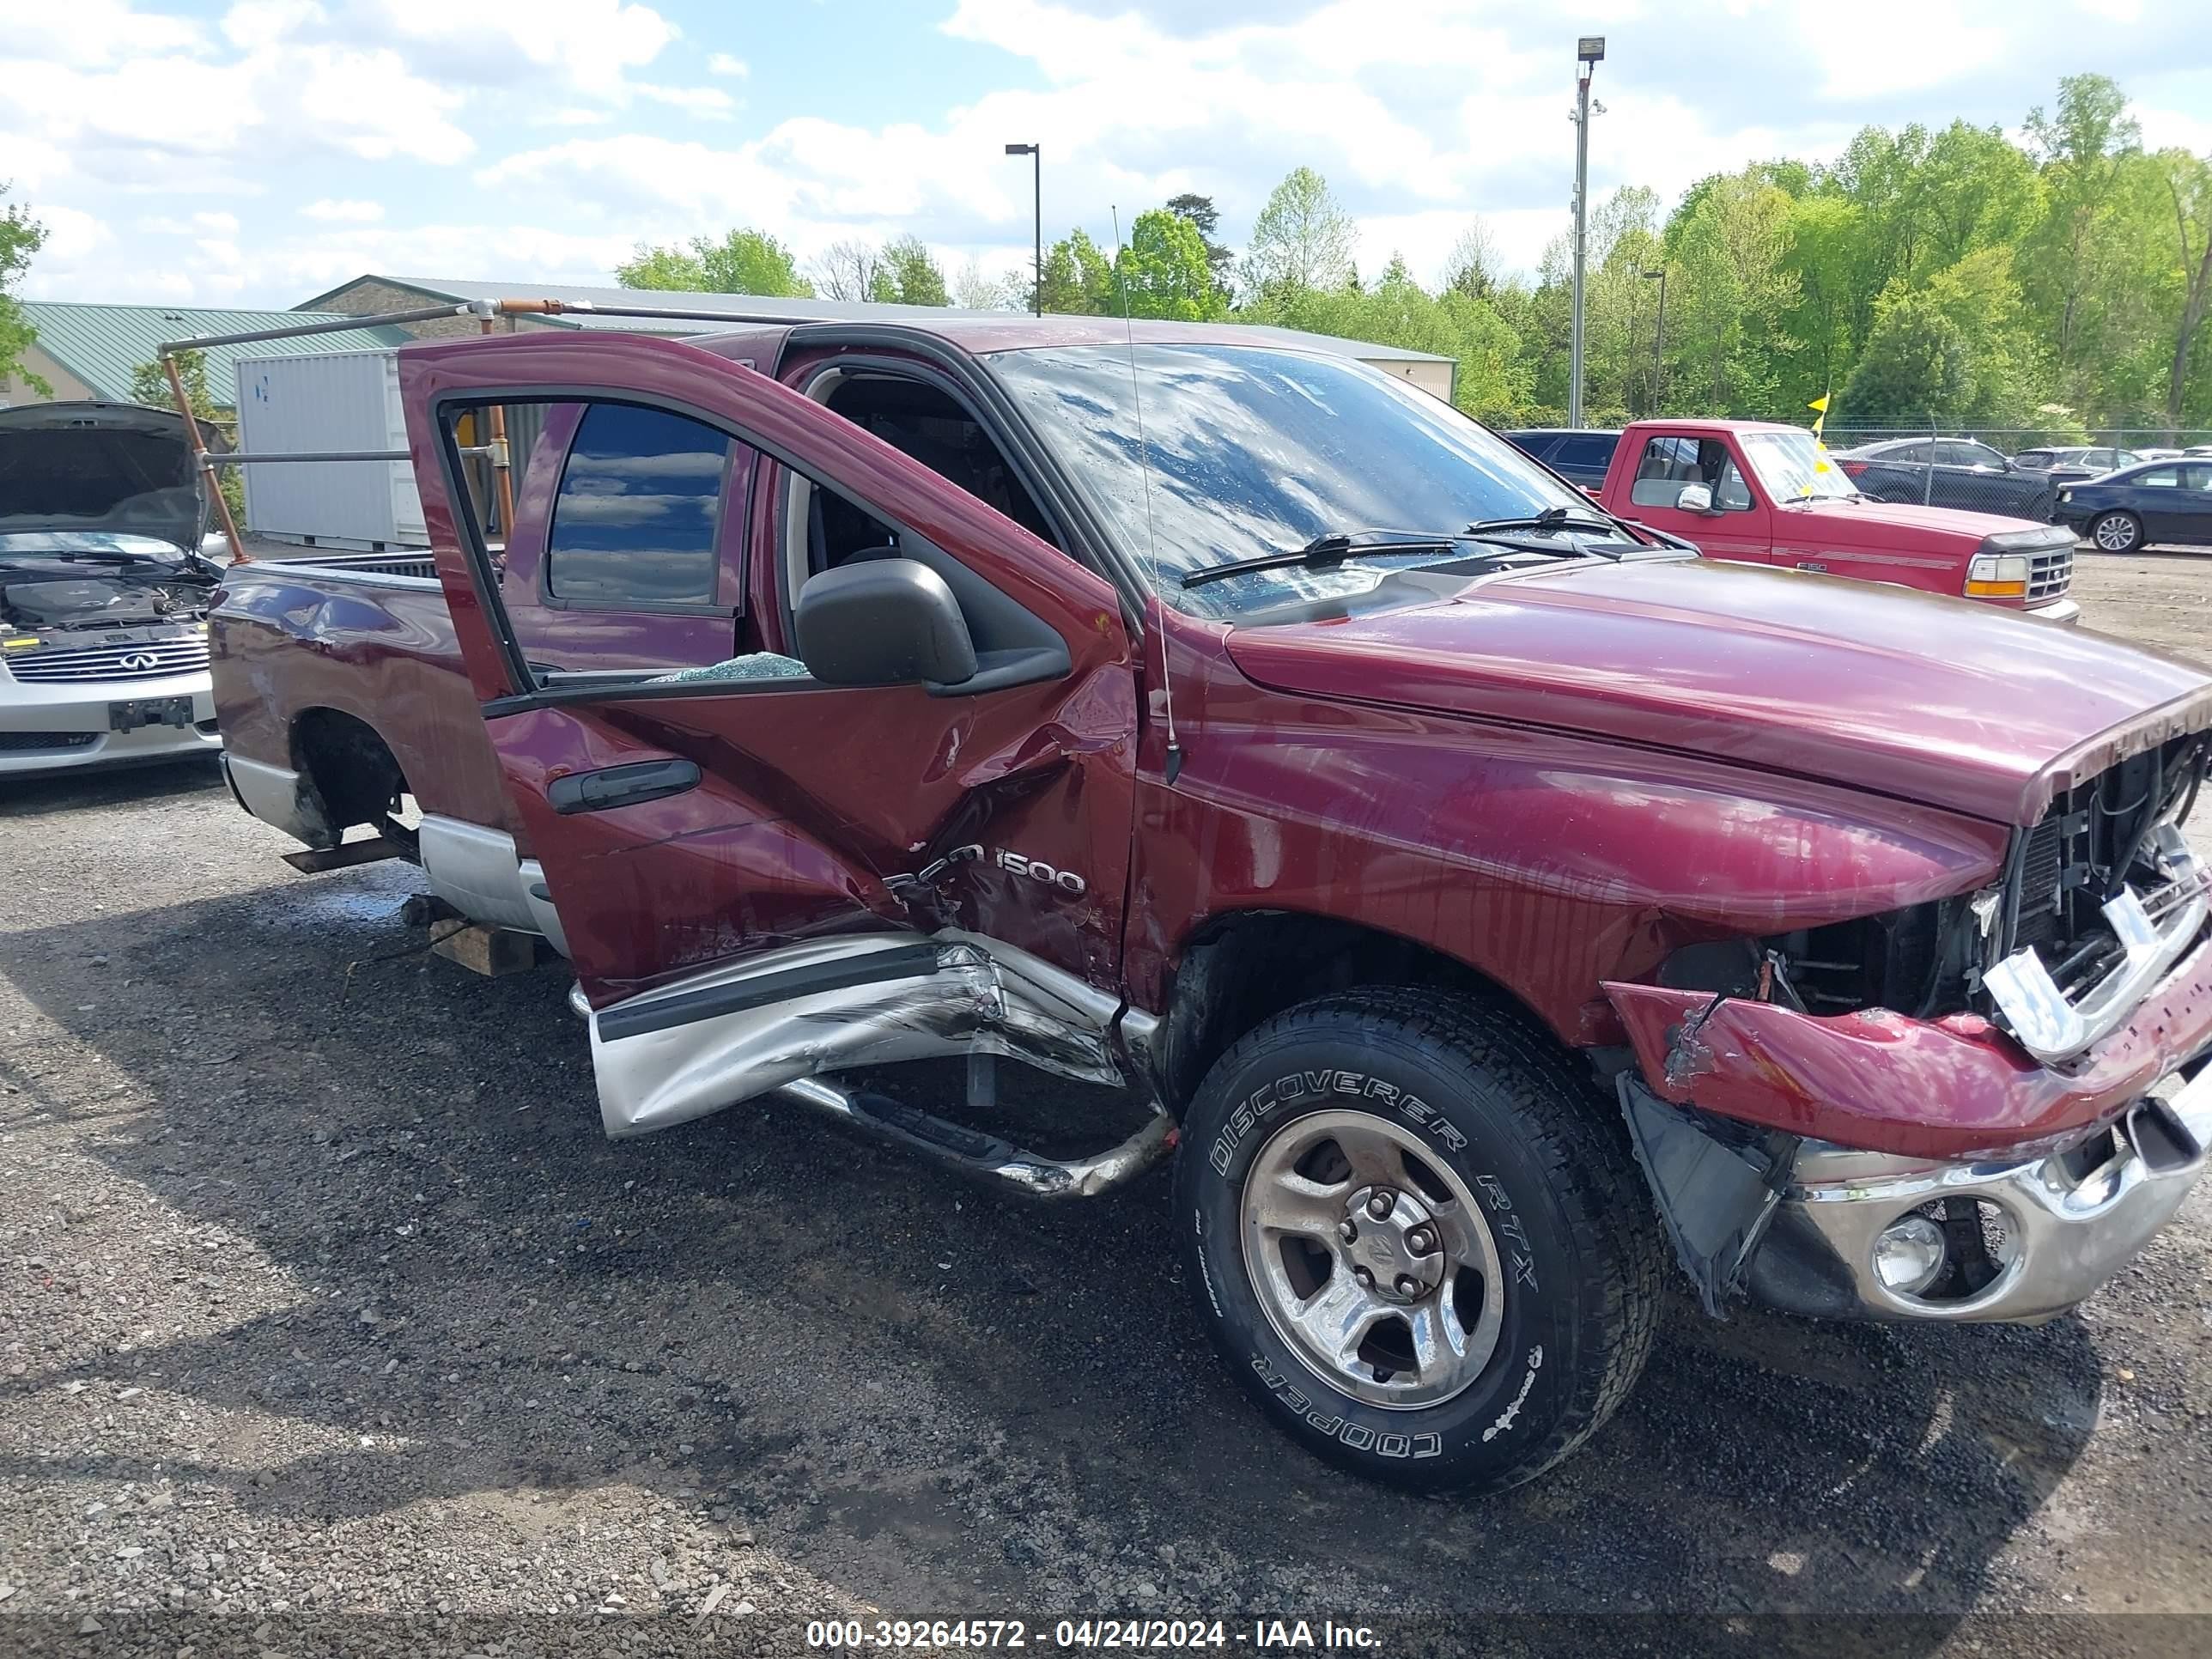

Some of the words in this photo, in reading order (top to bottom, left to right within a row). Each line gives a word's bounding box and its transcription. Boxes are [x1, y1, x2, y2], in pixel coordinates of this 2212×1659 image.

[994, 847, 1086, 894] 1500
[1209, 1069, 1469, 1178] DISCOVERER
[1250, 1354, 1443, 1459] COOPER
